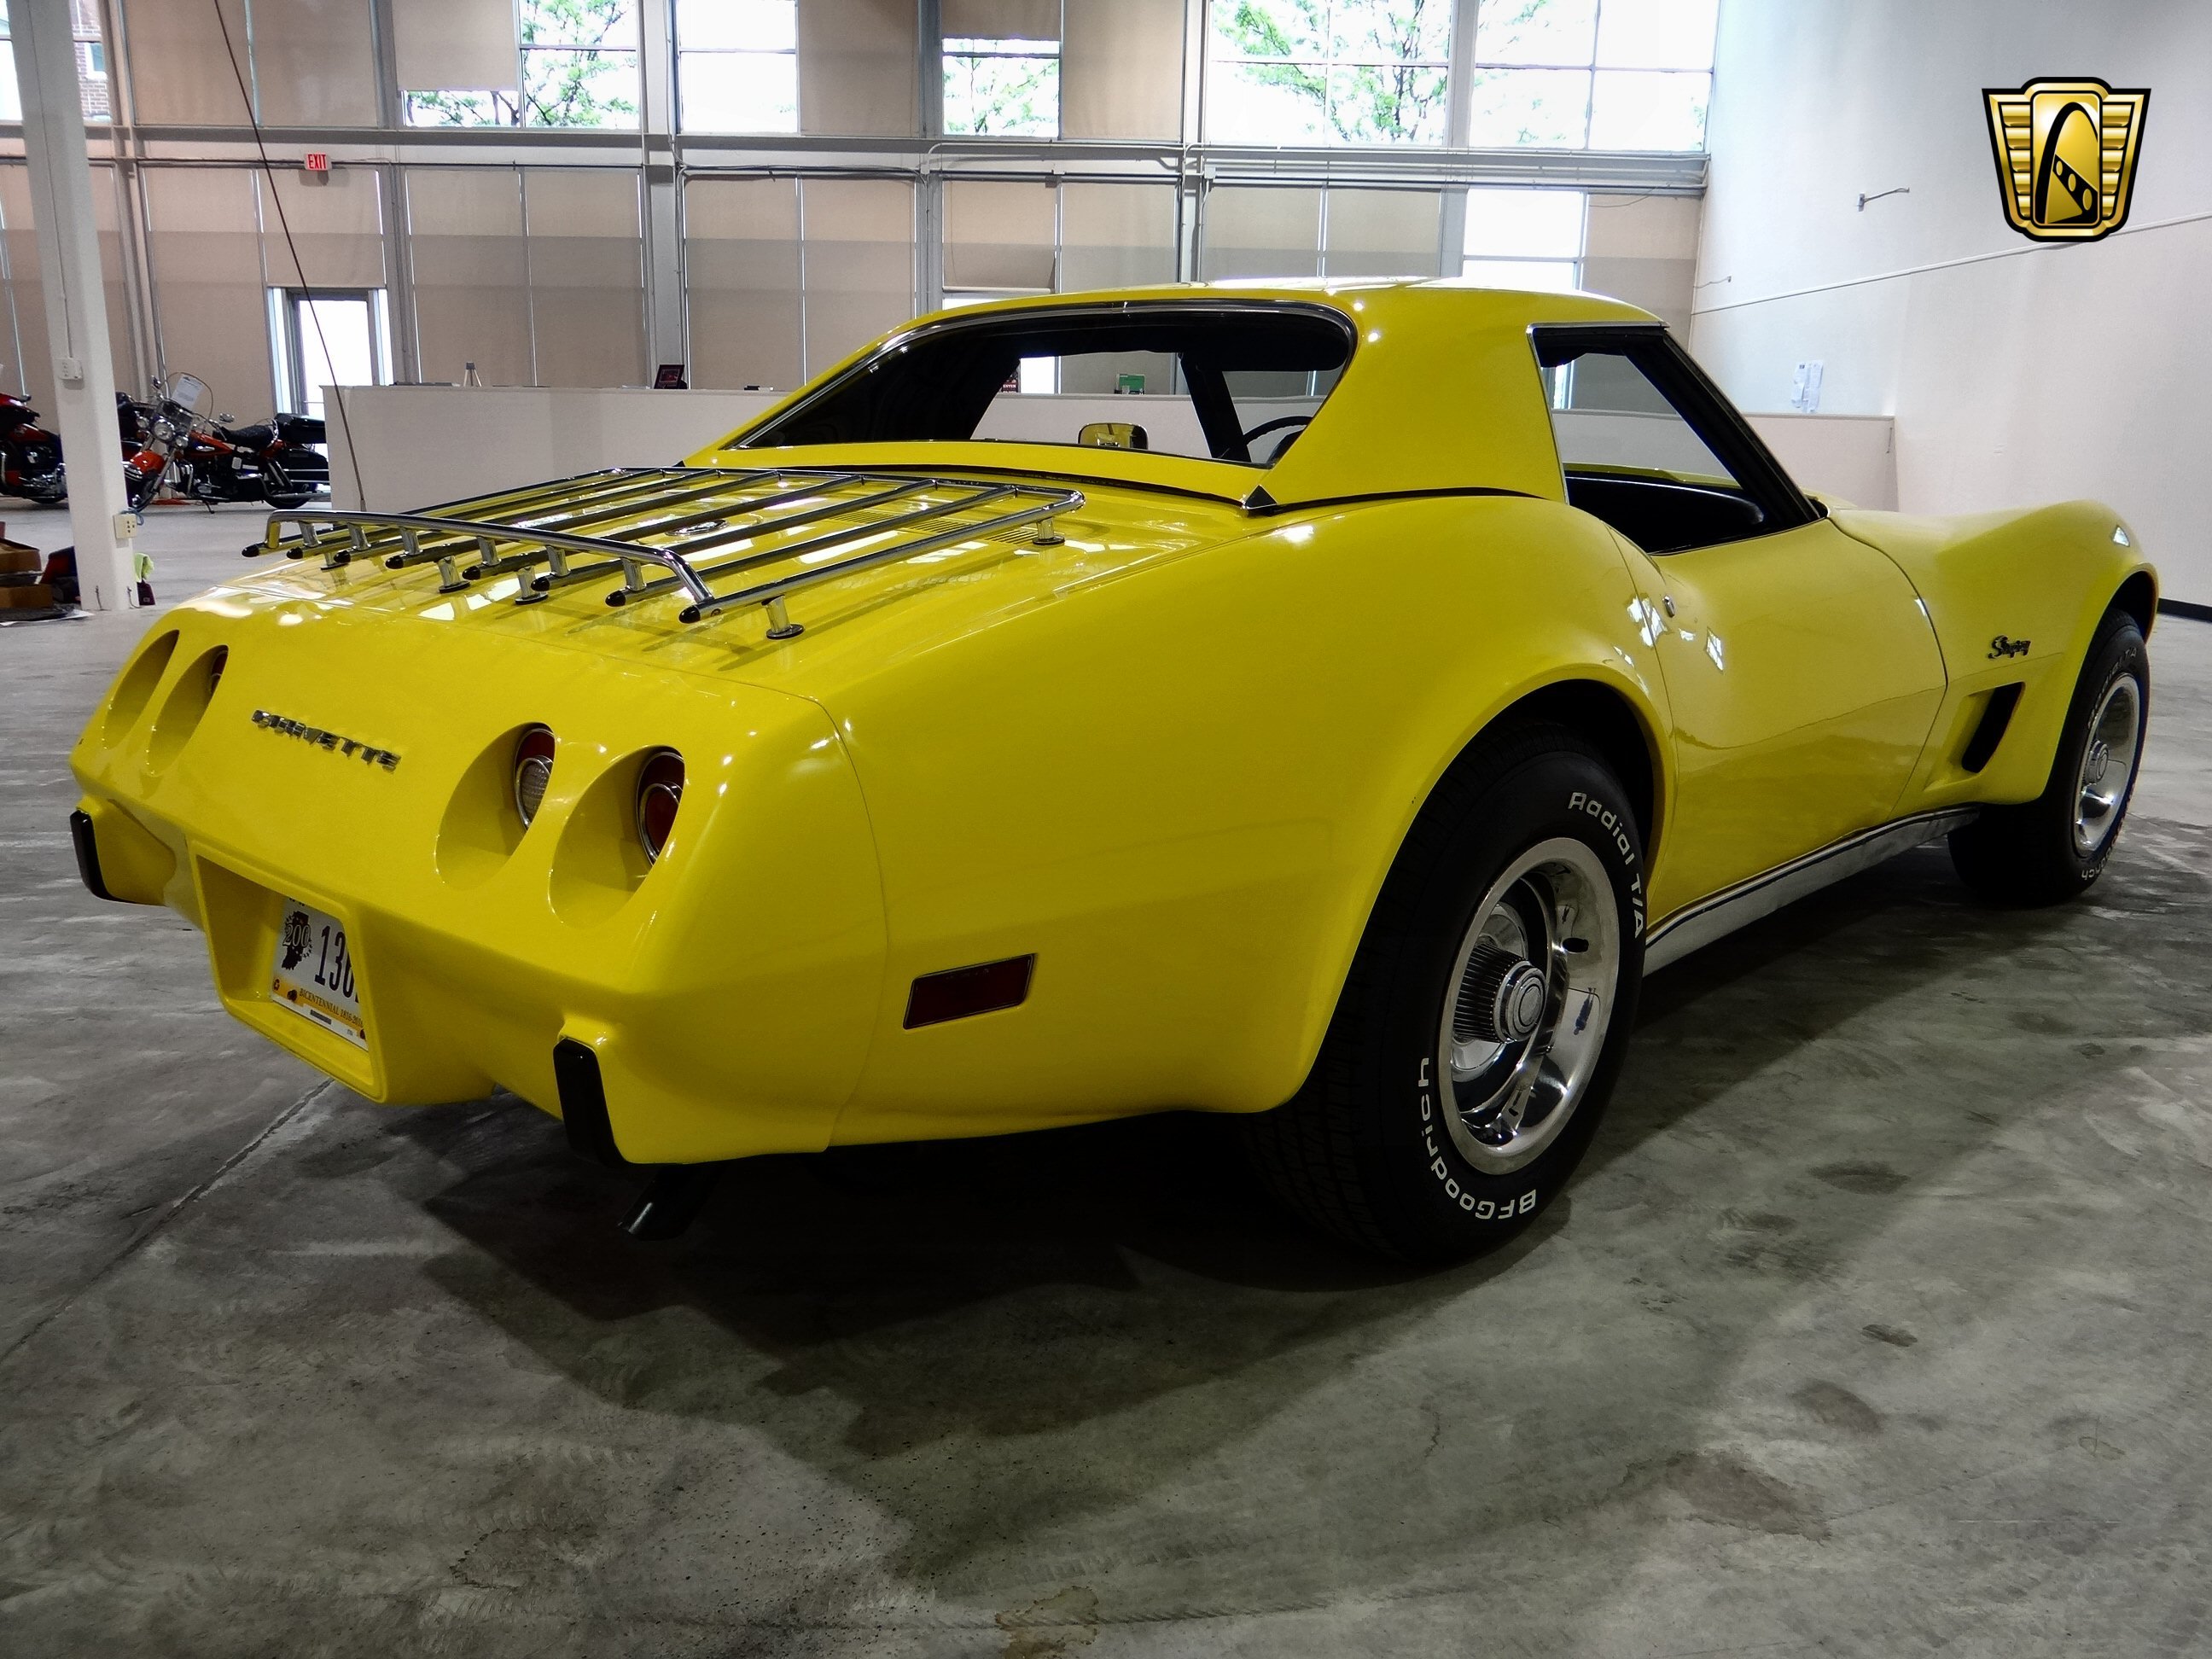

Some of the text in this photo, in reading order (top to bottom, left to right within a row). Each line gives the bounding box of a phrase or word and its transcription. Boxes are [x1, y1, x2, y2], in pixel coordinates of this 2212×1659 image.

[308, 154, 327, 170] EXIT
[251, 709, 402, 771] CORVETTE
[1568, 791, 1644, 940] Radial T/A
[282, 923, 311, 947] 200
[314, 925, 359, 1004] 136
[299, 987, 340, 1016] BICENTENNIAL
[1419, 1057, 1537, 1220] BFGoodrich
